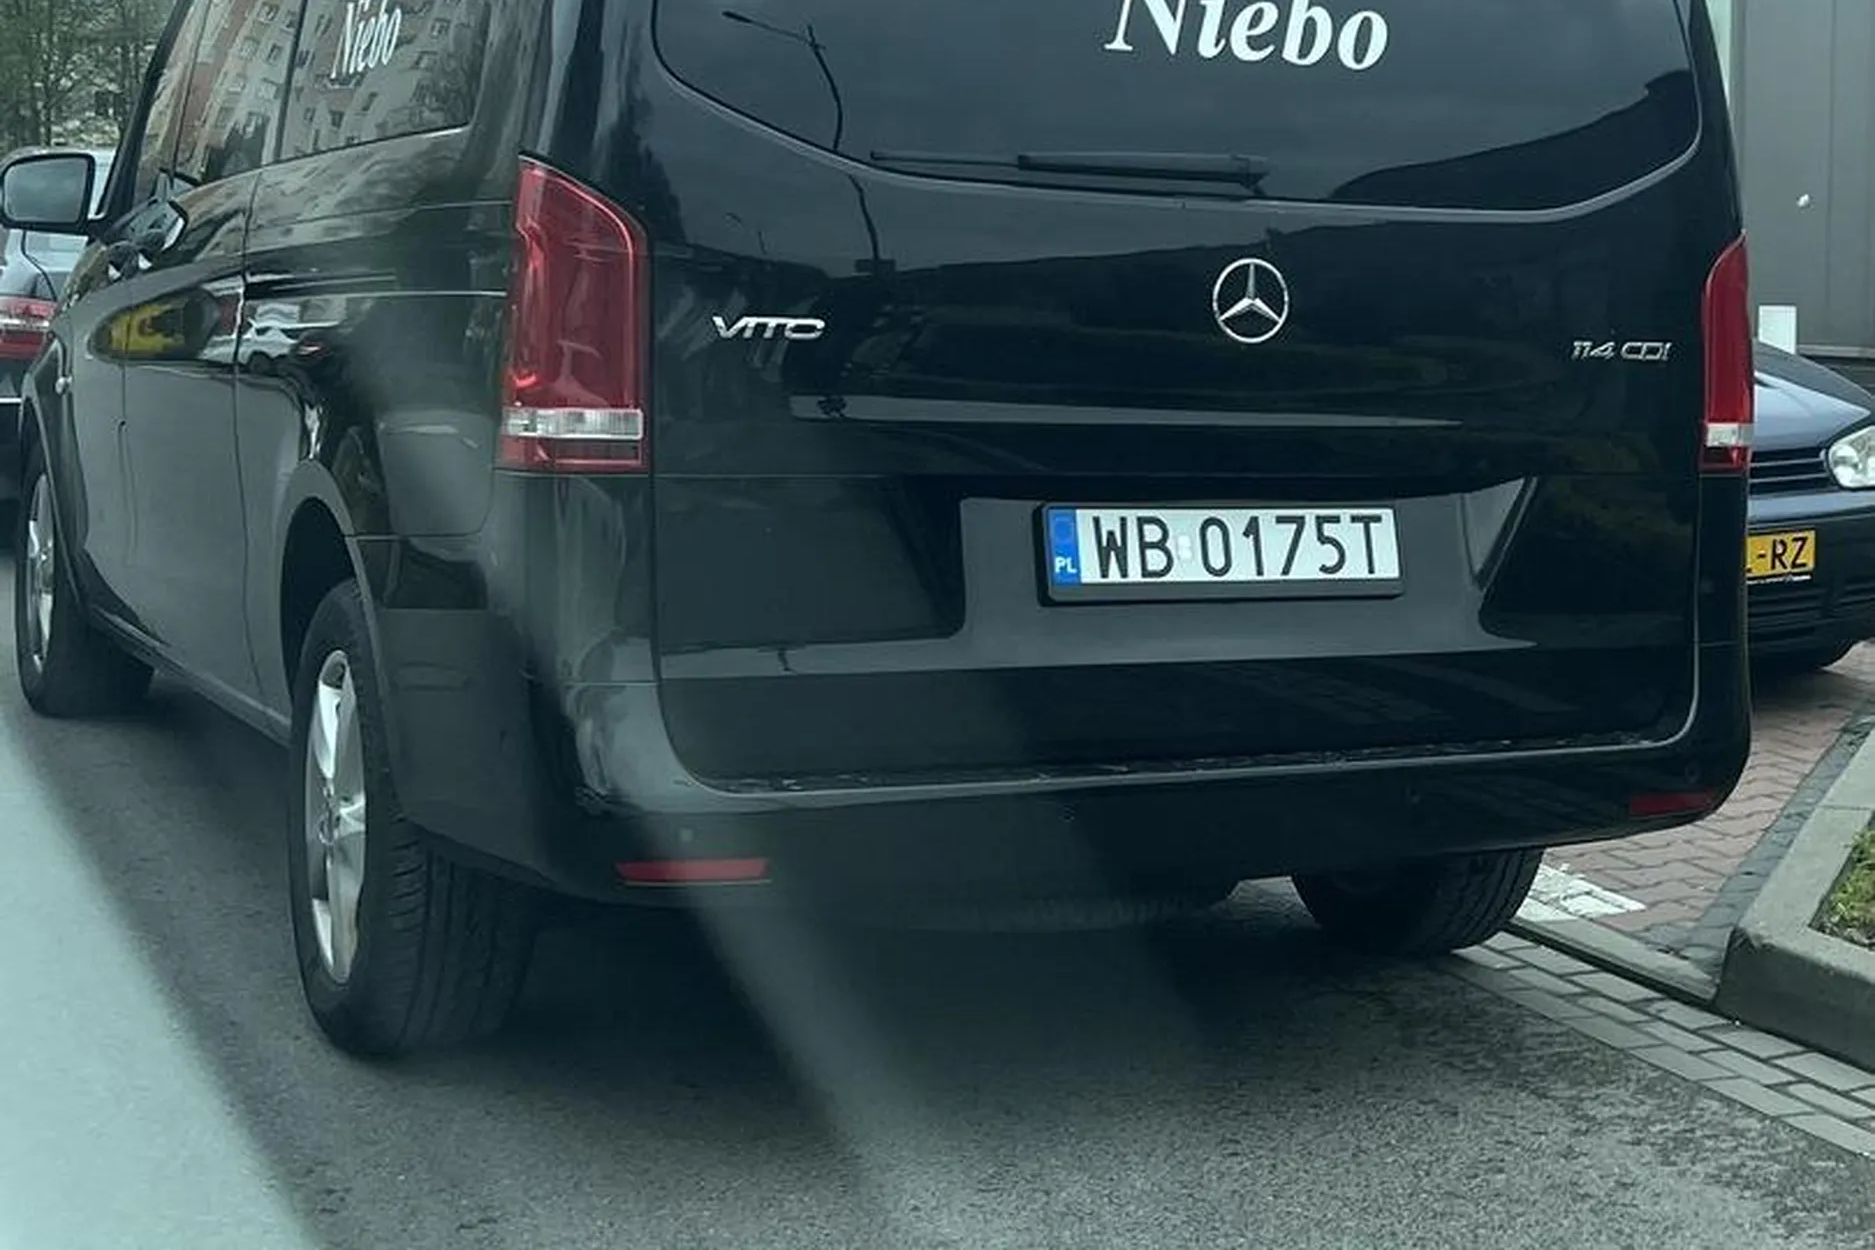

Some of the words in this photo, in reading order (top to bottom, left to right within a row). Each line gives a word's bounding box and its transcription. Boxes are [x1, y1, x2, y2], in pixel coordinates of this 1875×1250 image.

[712, 316, 825, 339] VITO
[1572, 341, 1615, 361] 114
[1621, 341, 1672, 361] CDI
[1092, 516, 1174, 579] WB
[1199, 515, 1382, 577] 0175T
[1055, 556, 1077, 574] PL
